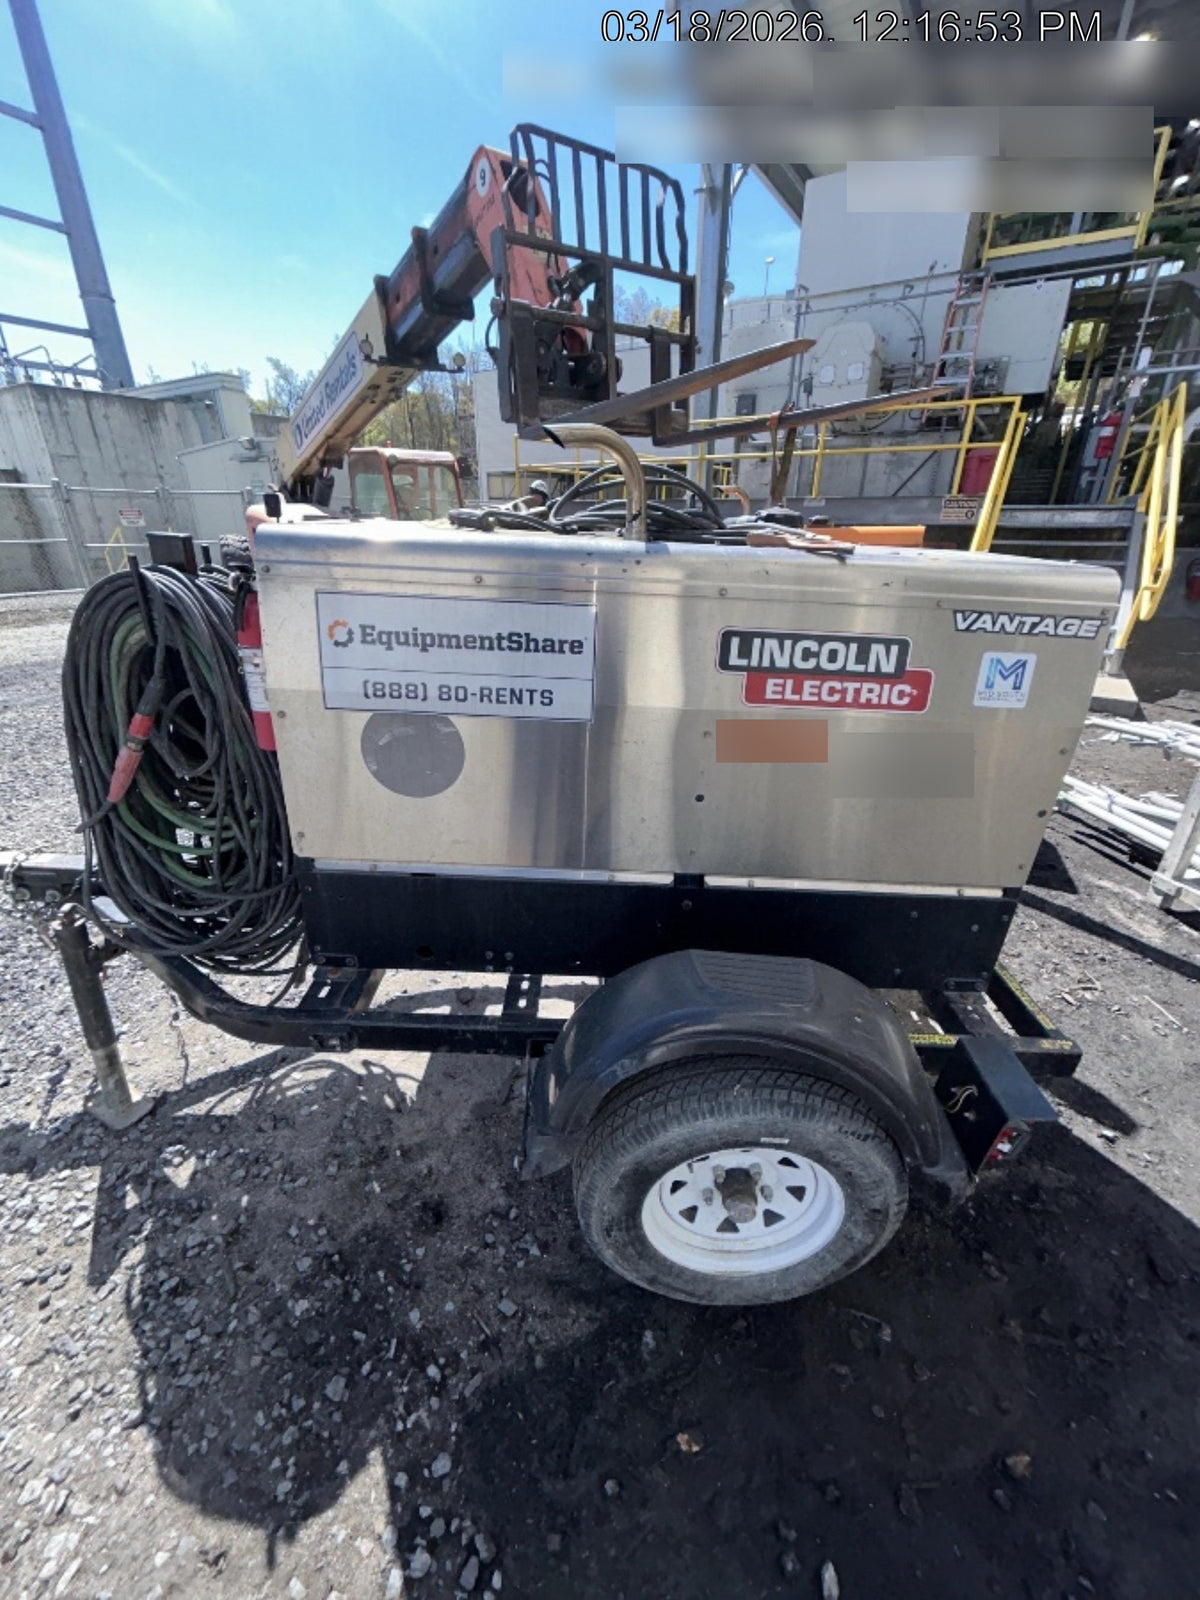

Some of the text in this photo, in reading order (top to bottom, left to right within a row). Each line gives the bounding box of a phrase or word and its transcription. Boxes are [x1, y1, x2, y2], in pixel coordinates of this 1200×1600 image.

[955, 611, 1102, 638] VANTAGE
[359, 623, 584, 655] EquipmentShare
[728, 636, 899, 674] LINCOLN
[362, 679, 554, 707] (888) 80-RENTS
[765, 678, 914, 706] ELECTRIC
